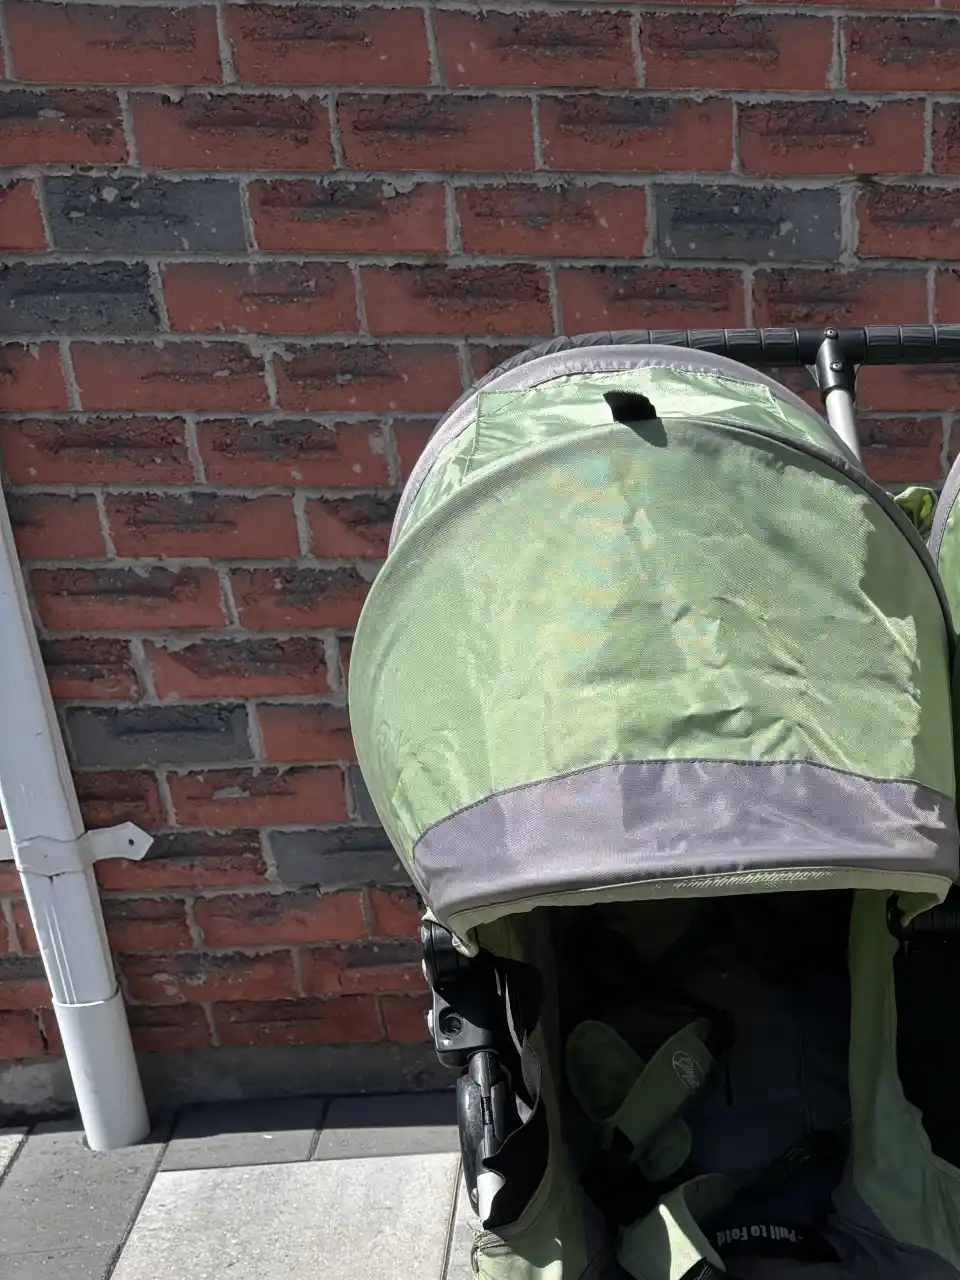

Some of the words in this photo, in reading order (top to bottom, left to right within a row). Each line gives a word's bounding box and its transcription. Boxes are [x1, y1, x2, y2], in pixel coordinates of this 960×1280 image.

[715, 1225, 749, 1248] Fold
[750, 1224, 768, 1238] to
[769, 1223, 799, 1243] Pull
